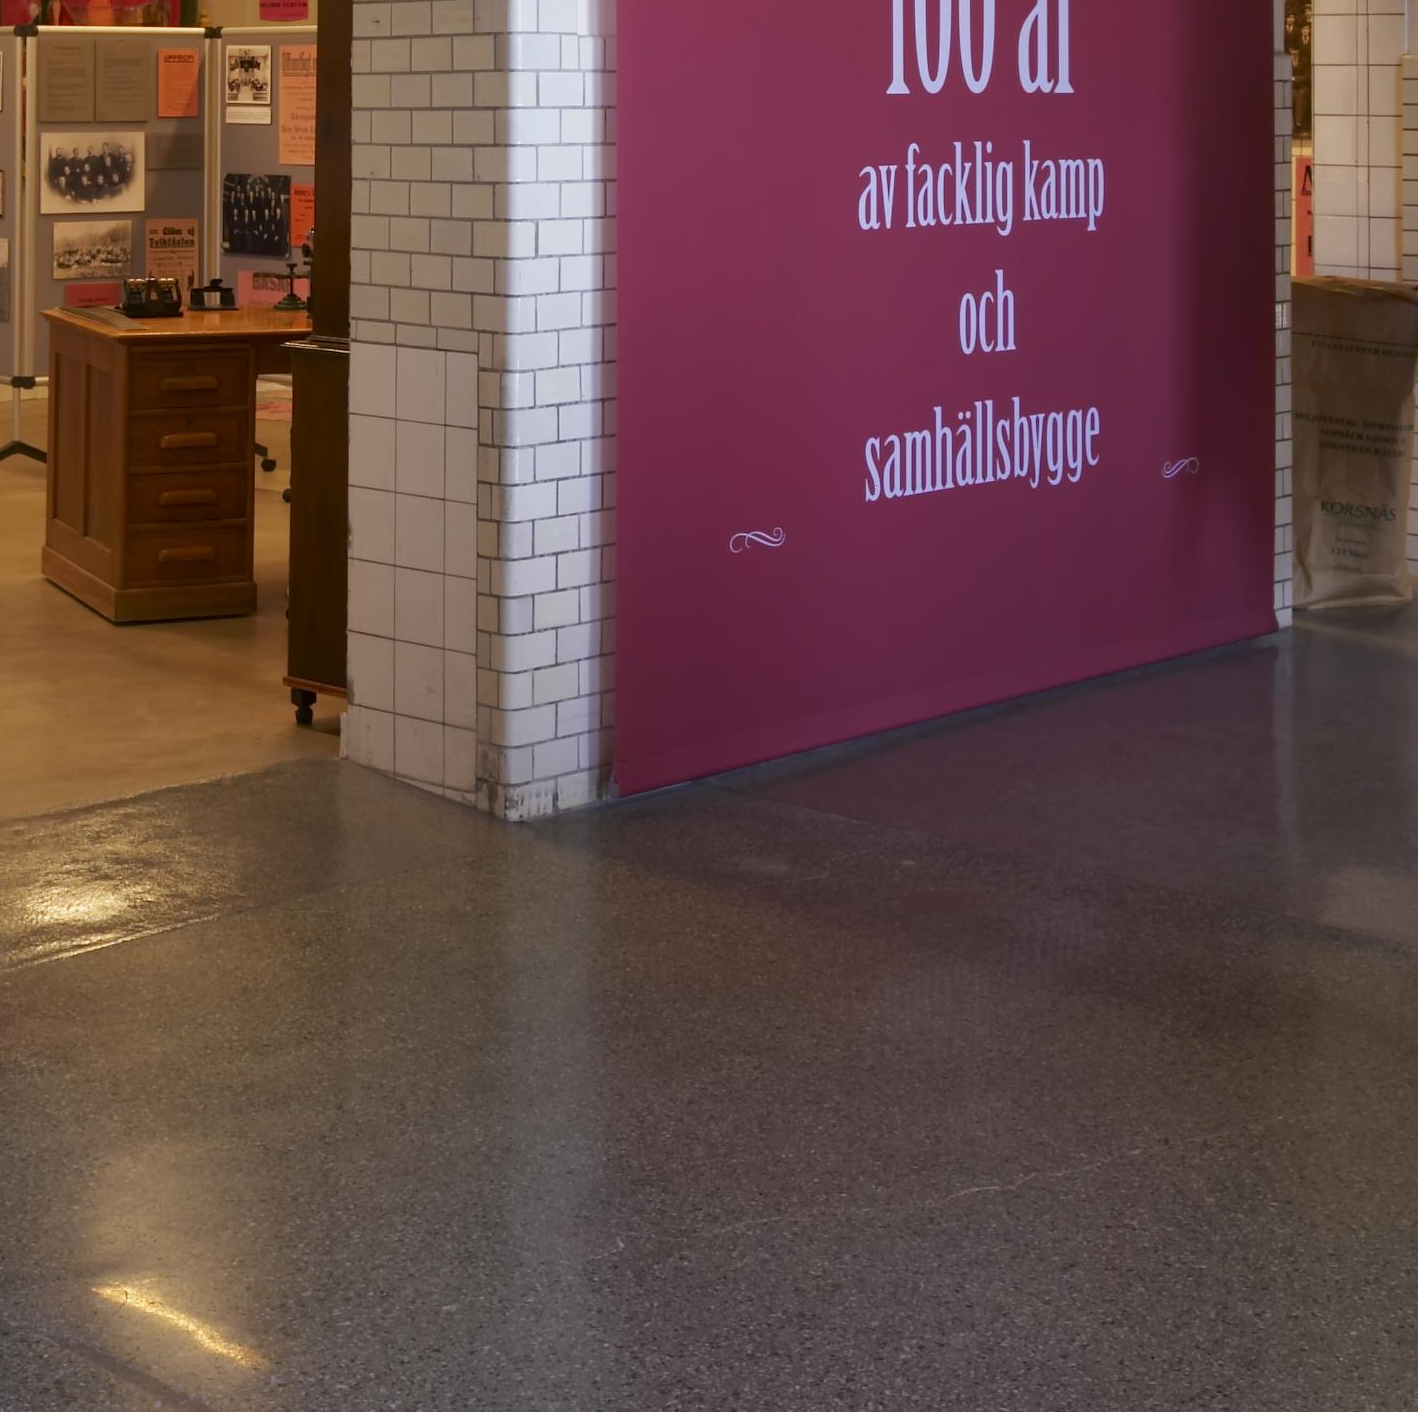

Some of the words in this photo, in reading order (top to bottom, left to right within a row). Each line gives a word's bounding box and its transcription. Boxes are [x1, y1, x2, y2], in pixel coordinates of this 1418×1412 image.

[859, 165, 897, 229] av
[906, 142, 1012, 236] facklig
[1024, 140, 1103, 230] kamp
[960, 270, 1015, 354] och
[866, 397, 1099, 501] samhällsbygge
[1320, 500, 1397, 522] KORSNÄS
